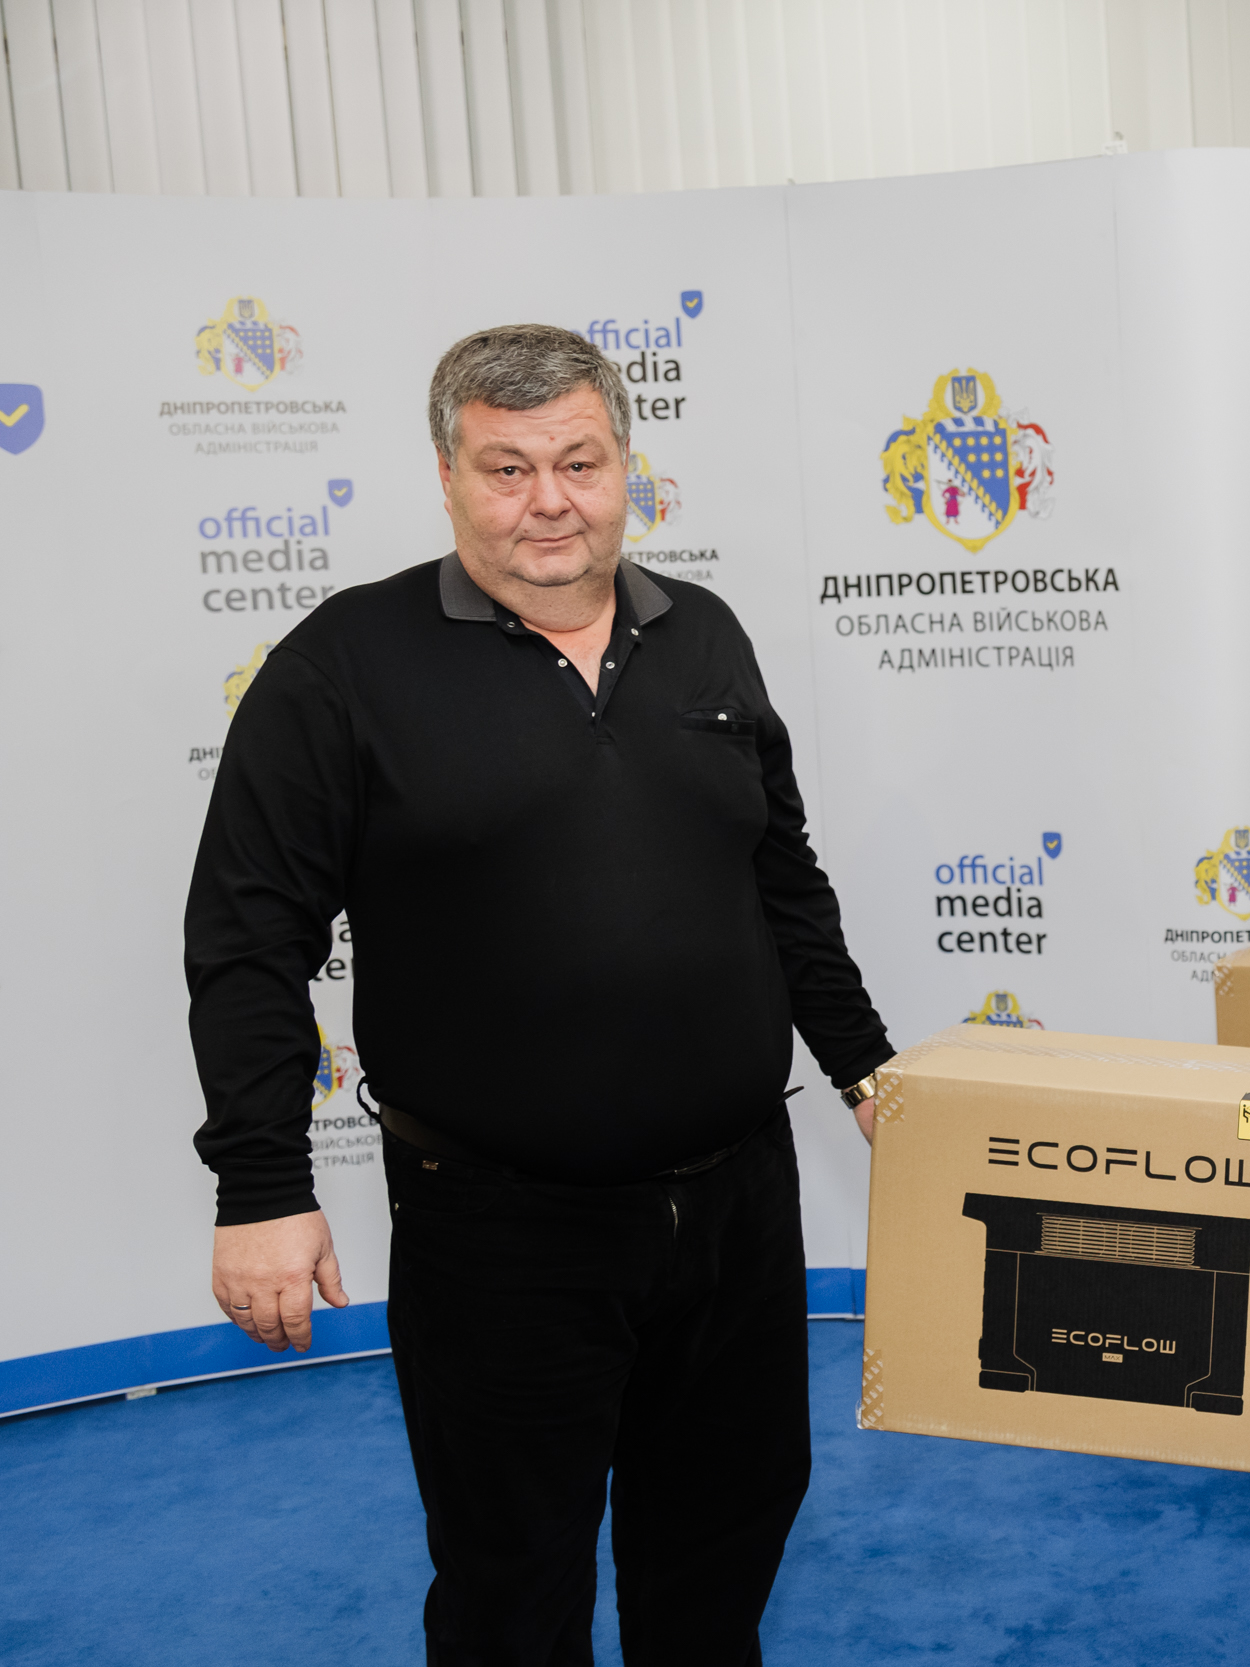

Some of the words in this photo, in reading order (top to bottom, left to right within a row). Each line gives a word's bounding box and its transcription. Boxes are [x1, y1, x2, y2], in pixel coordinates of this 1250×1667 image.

[570, 317, 682, 351] fficial
[159, 400, 347, 417] ДНІПРОПЕТРОВСЬКА
[634, 394, 686, 421] ter
[168, 421, 247, 437] ОБЛАСНА
[251, 420, 340, 435] ВІЙСЬКОВА
[194, 440, 319, 455] АДМІНІСТРАЦІЯ
[199, 505, 330, 539] official
[200, 539, 330, 573] media
[203, 582, 335, 613] center
[820, 567, 1120, 605] ДНІПРОПЕТРОВСЬКА
[835, 611, 964, 637] ОБЛАСНА
[973, 607, 1109, 633] ВІЙСЬКОВА
[878, 646, 1075, 674] АДМІНІСТРАЦІЯ
[935, 854, 1044, 885] official
[936, 886, 1043, 919] media
[937, 927, 1048, 955] center
[1051, 1328, 1176, 1354] ECOFLOW
